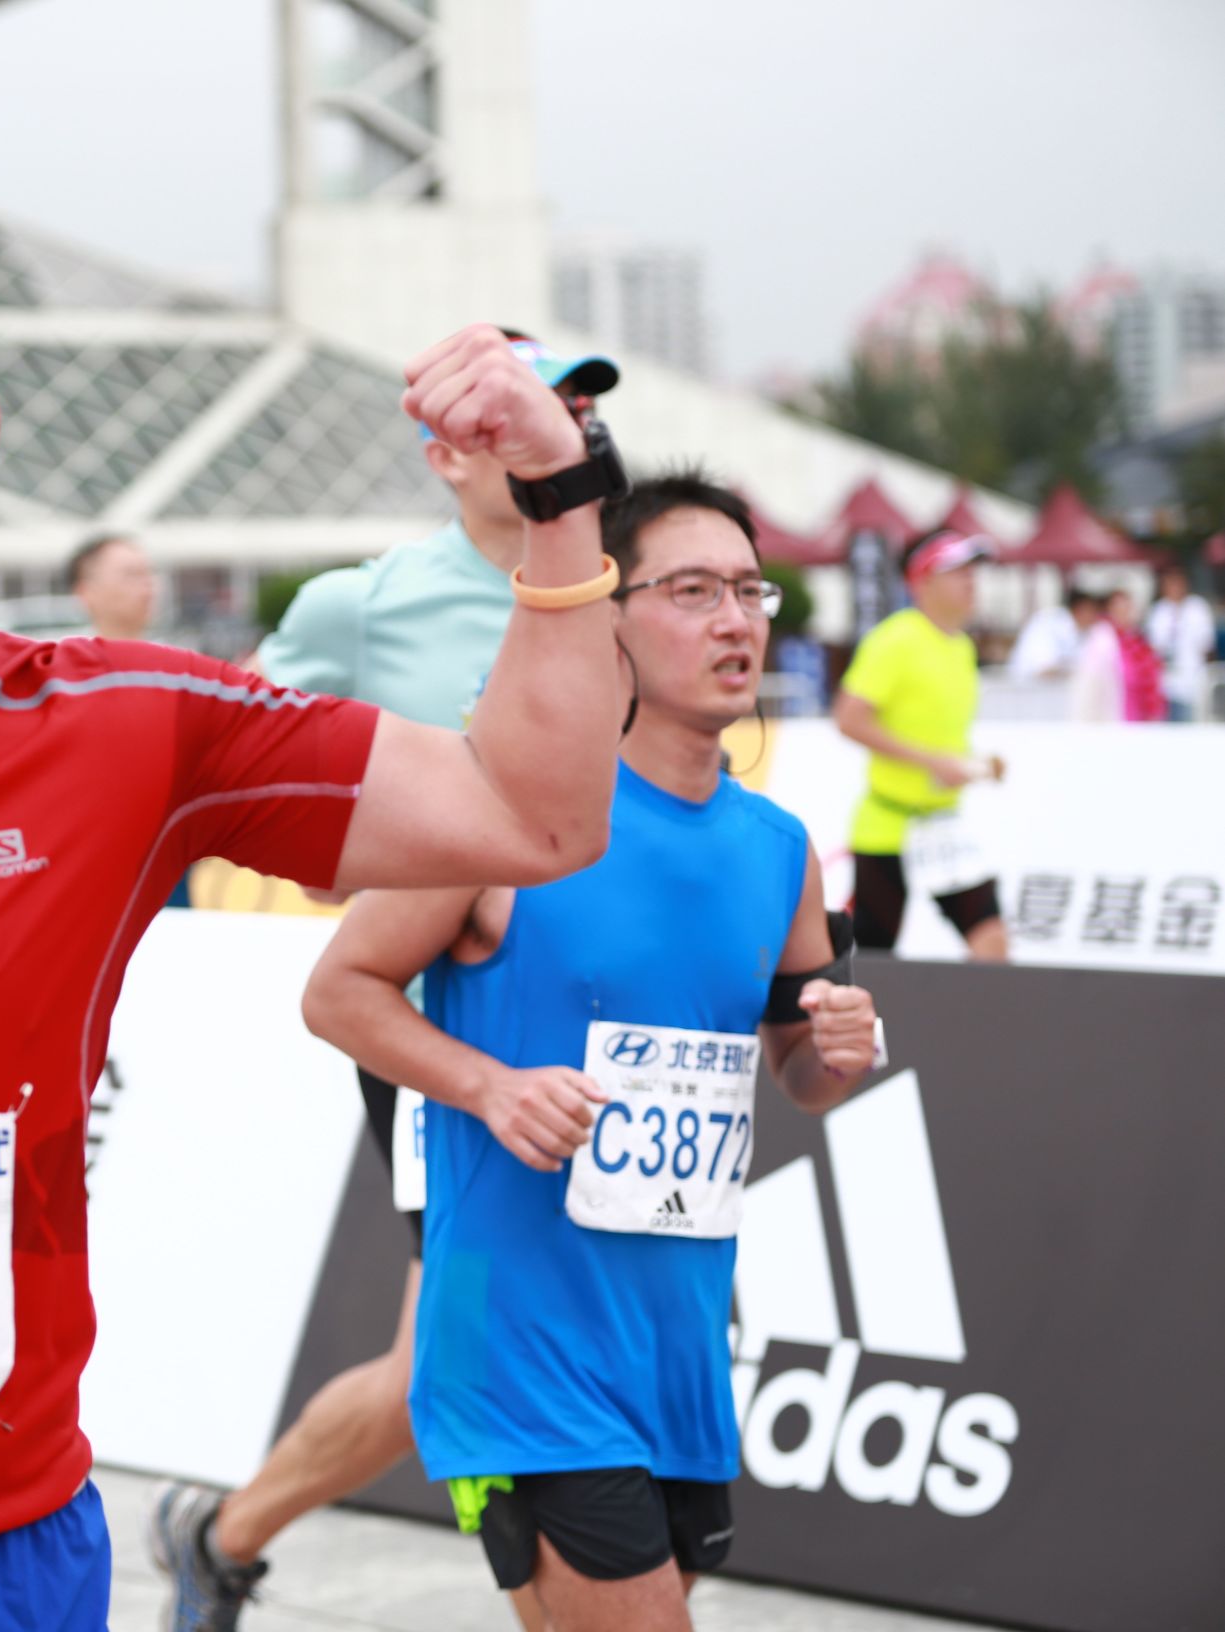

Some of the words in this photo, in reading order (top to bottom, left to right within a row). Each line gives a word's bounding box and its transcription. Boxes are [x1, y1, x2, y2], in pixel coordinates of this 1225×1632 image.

[1009, 873, 1222, 949] 夏基金
[591, 1100, 751, 1182] C3872
